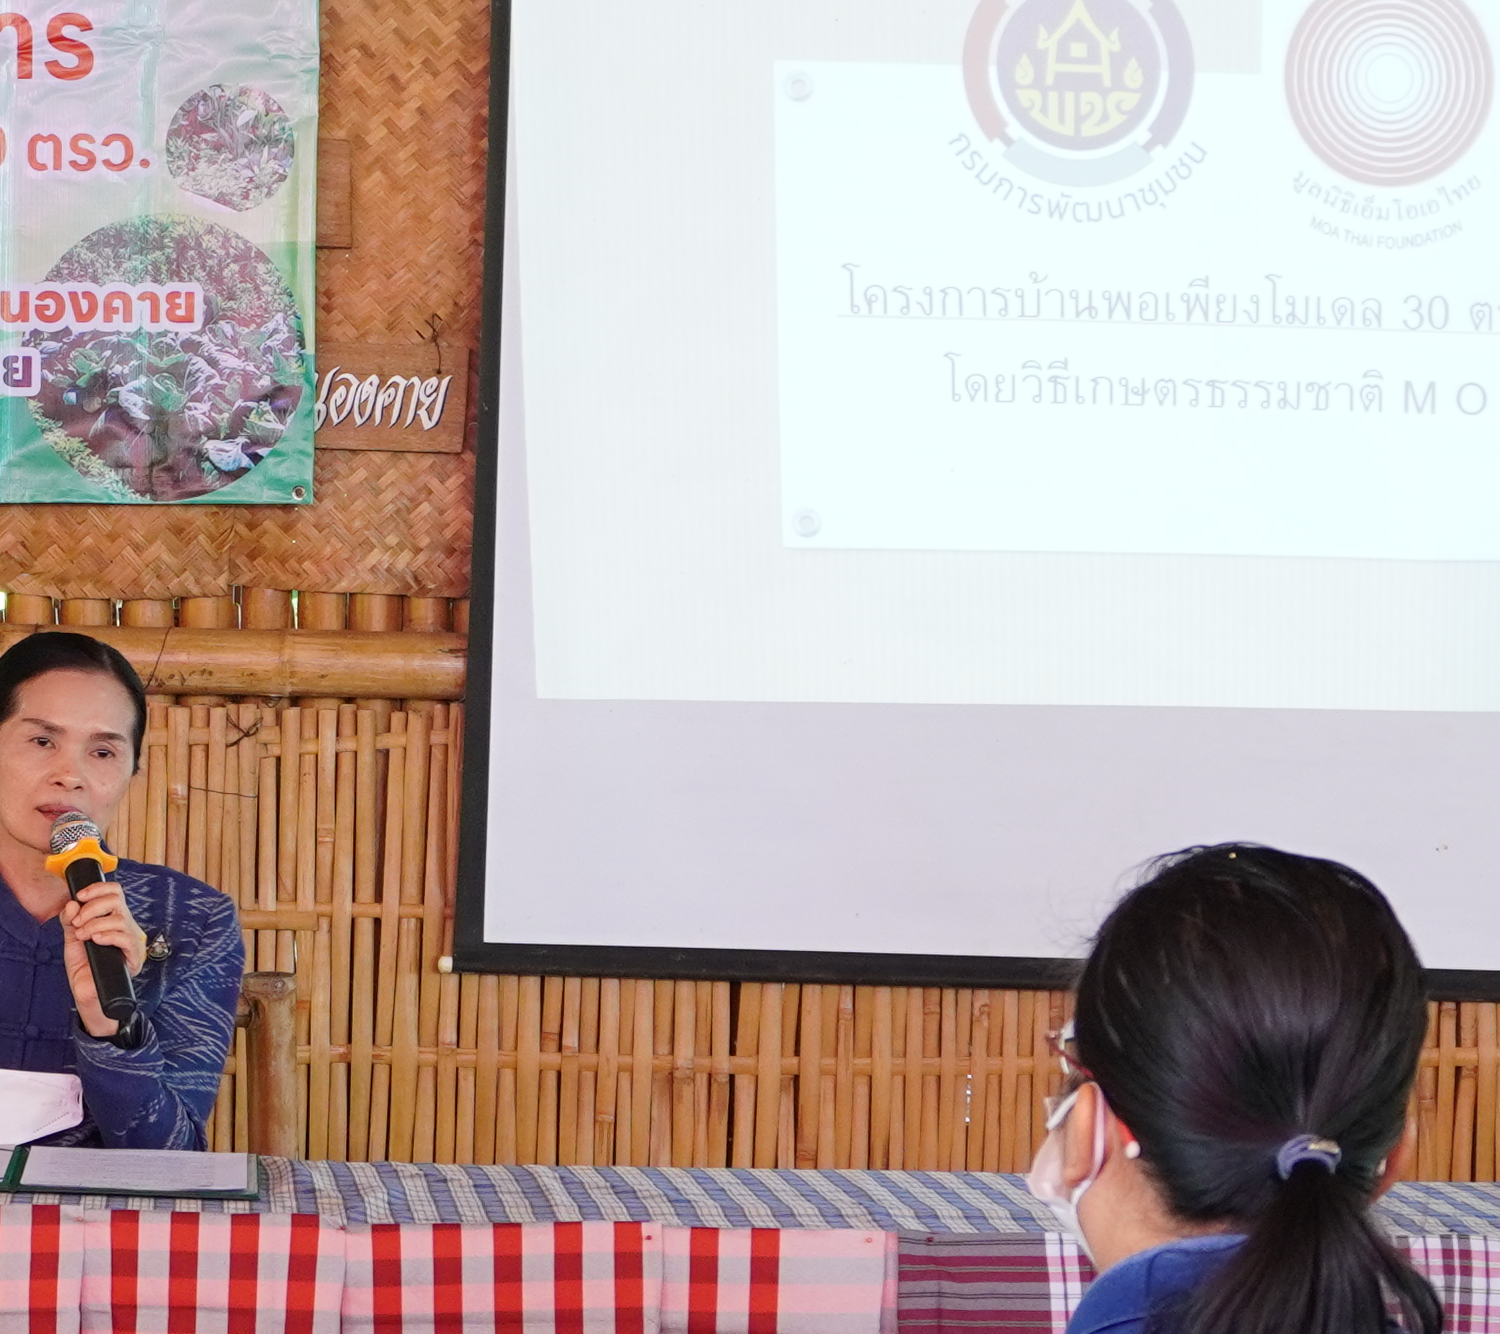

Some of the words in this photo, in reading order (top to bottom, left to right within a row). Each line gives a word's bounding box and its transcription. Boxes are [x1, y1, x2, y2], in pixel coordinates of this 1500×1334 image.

[26, 130, 152, 172] ตรว.
[946, 129, 1209, 225] กรมการพัฒนาชุมชน
[1310, 216, 1340, 239] MOA
[1344, 229, 1373, 247] THAI
[1377, 220, 1463, 249] FOUNDATION
[841, 262, 1385, 331] โครงการบ้านพอเพียงโมเดล
[1401, 294, 1451, 331] 30
[944, 352, 1385, 416] โดยวิธีเกษตรธรรมชาติ
